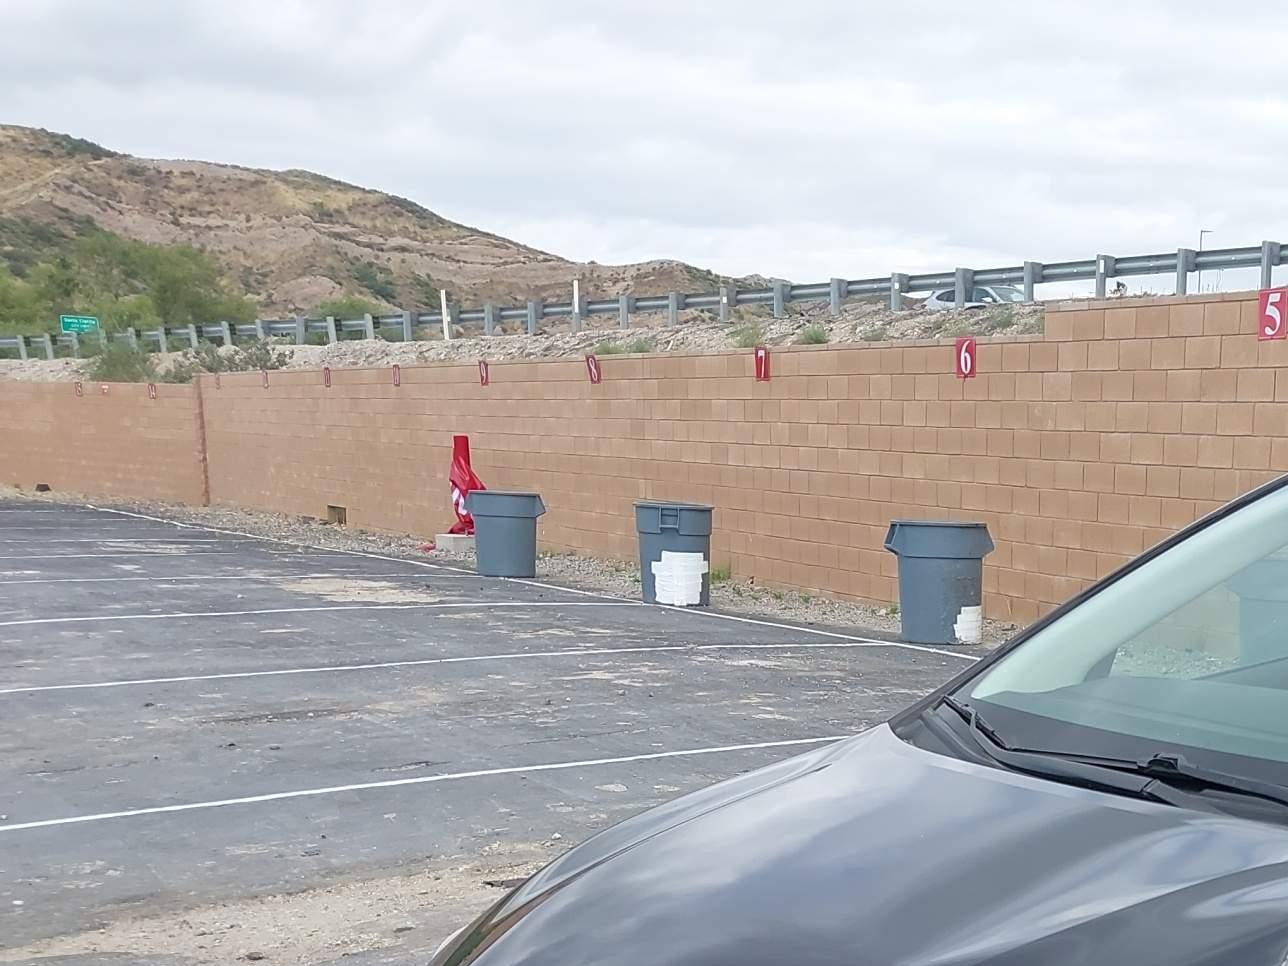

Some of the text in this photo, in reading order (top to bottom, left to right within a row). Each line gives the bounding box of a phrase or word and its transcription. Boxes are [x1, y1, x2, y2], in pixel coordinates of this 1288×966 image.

[1264, 292, 1281, 336] 5
[588, 357, 598, 381] 8
[757, 349, 765, 378] 7
[960, 340, 971, 374] 6
[480, 362, 487, 384] 9
